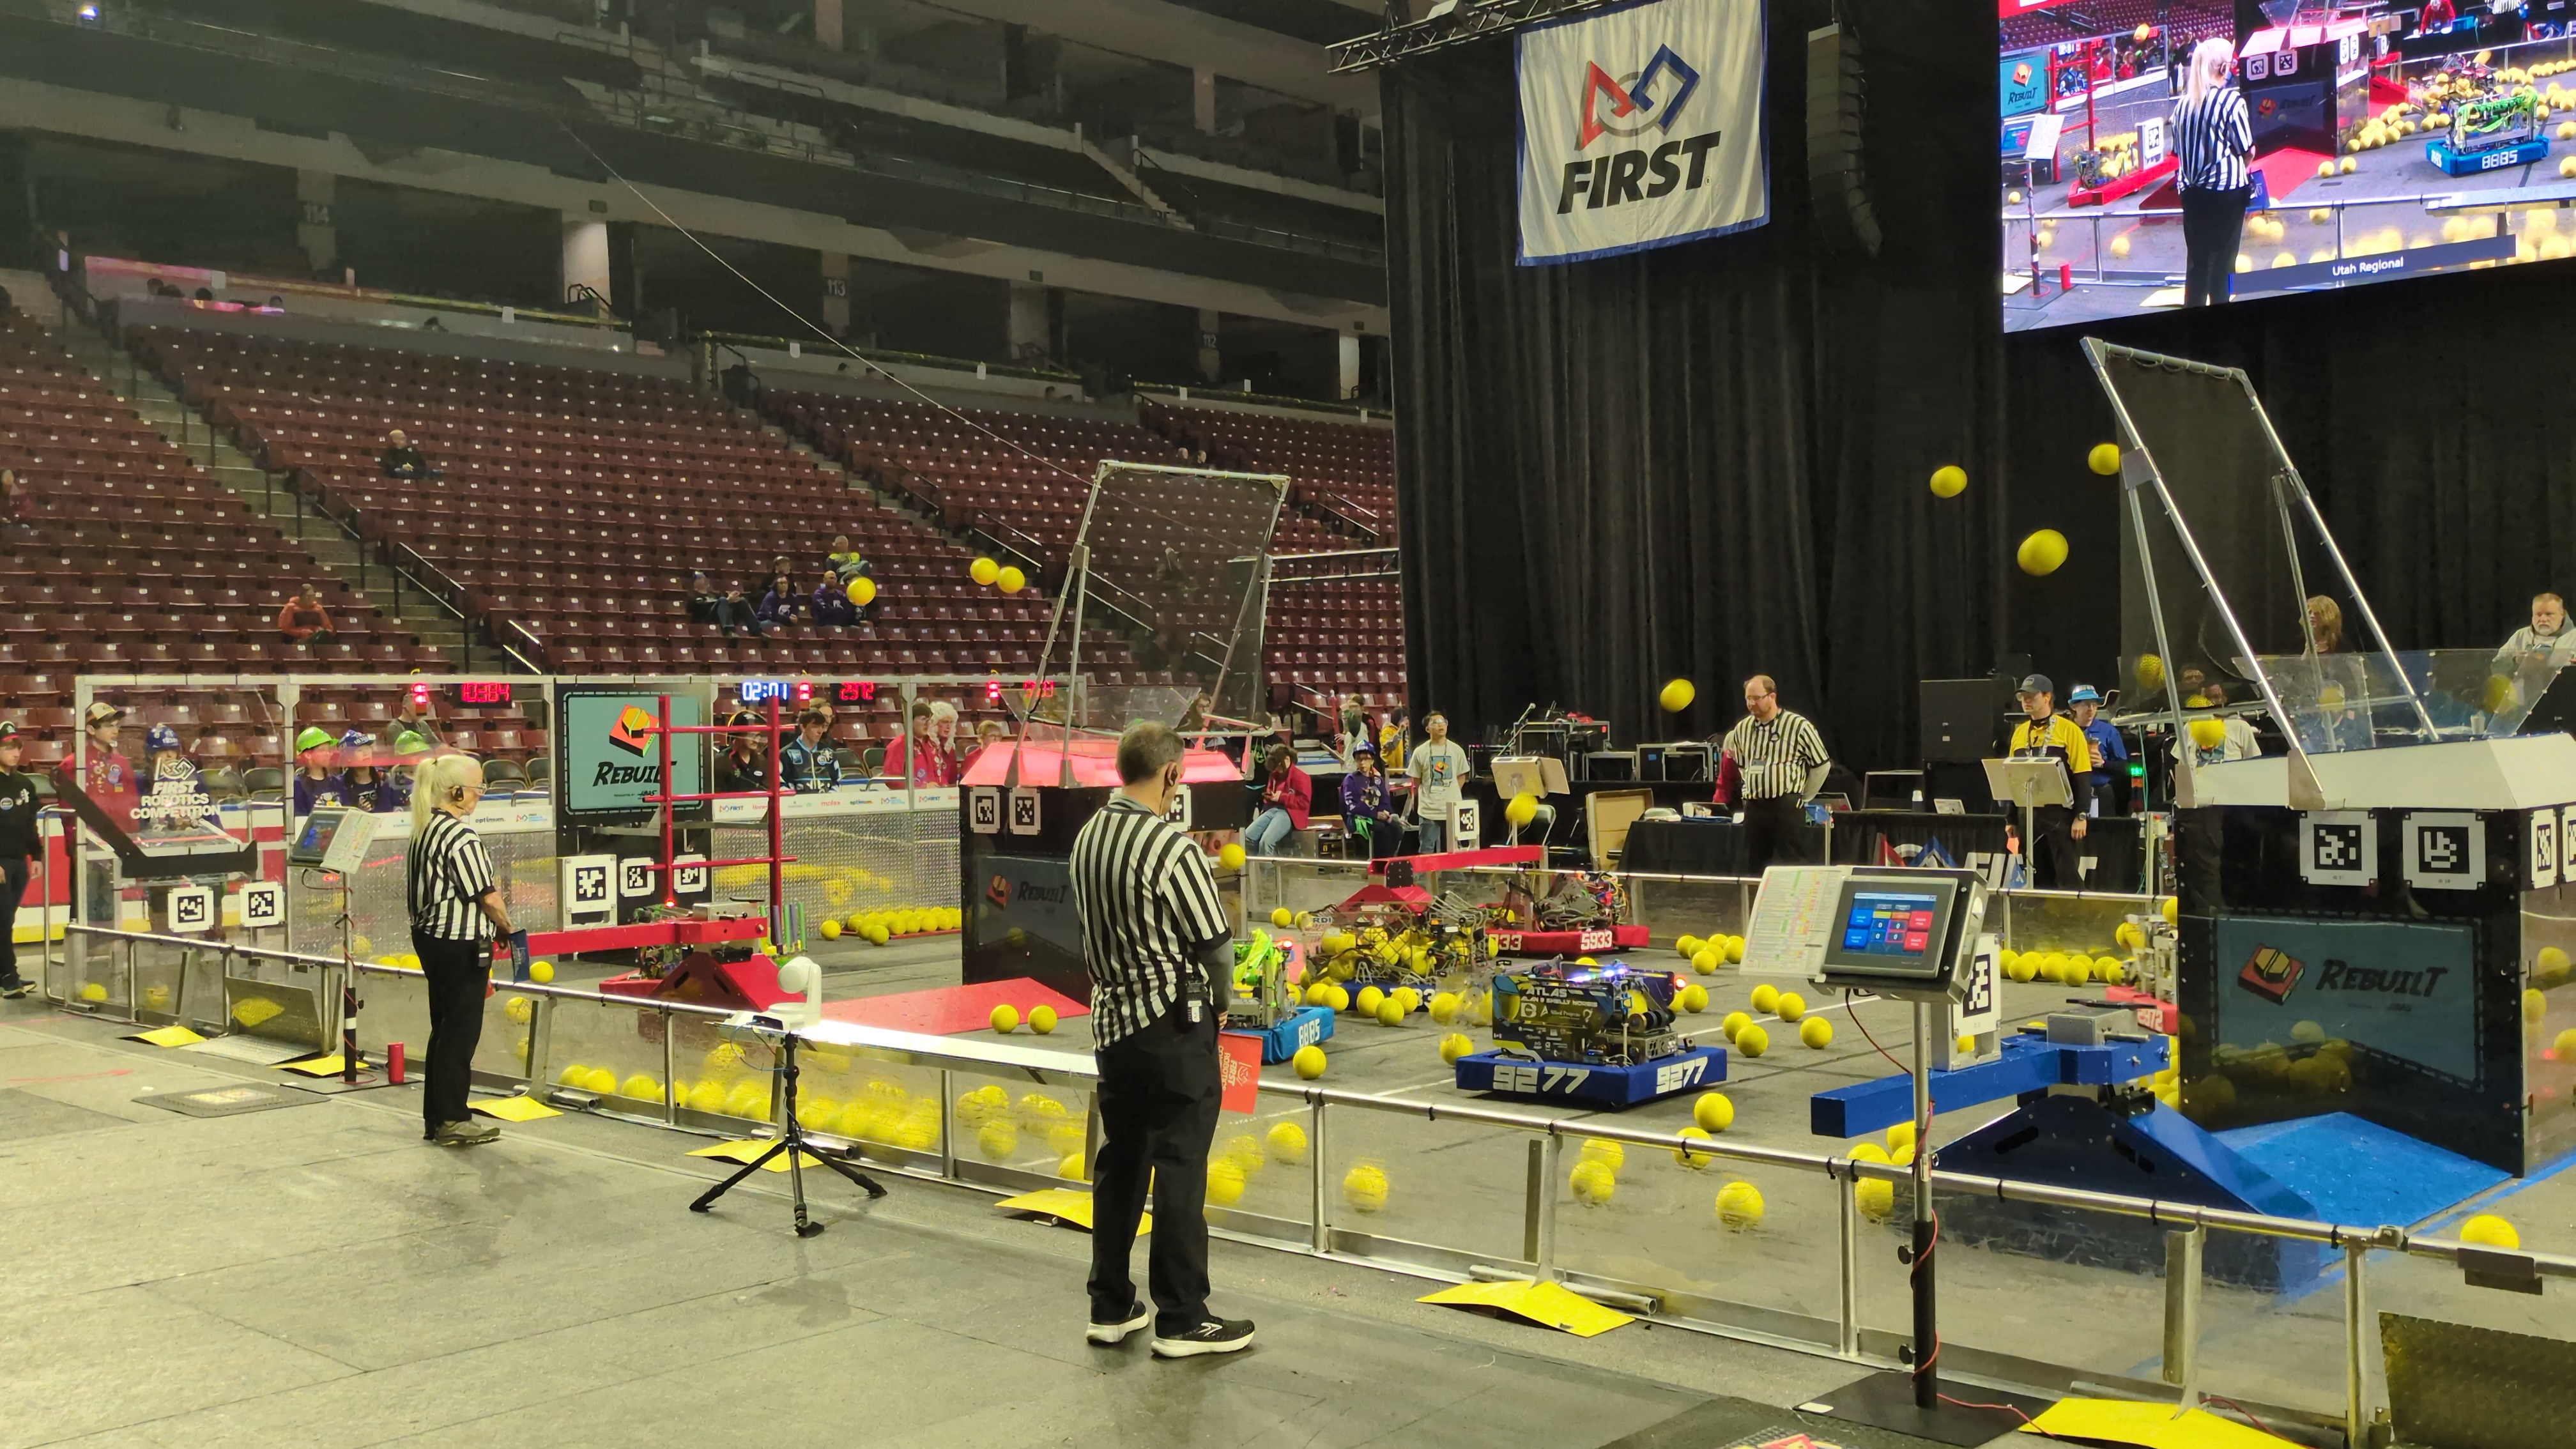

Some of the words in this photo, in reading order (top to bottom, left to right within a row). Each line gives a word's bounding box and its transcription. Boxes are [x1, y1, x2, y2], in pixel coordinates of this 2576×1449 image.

[1557, 130, 1721, 215] FIRST
[2333, 263, 2356, 276] Utah
[2359, 256, 2404, 273] Regional
[827, 279, 846, 296] 113
[742, 681, 787, 701] 02:01
[152, 780, 198, 794] FIRST
[141, 793, 210, 807] ROBOTICS
[130, 804, 221, 820] COMPETITION
[1581, 930, 1613, 951] 5933
[2315, 958, 2450, 997] REBUILT
[1526, 986, 1567, 998] ATLAS
[1227, 1059, 1238, 1087] FIRST
[1493, 1064, 1590, 1094] 9277
[1656, 1056, 1708, 1094] 9277
